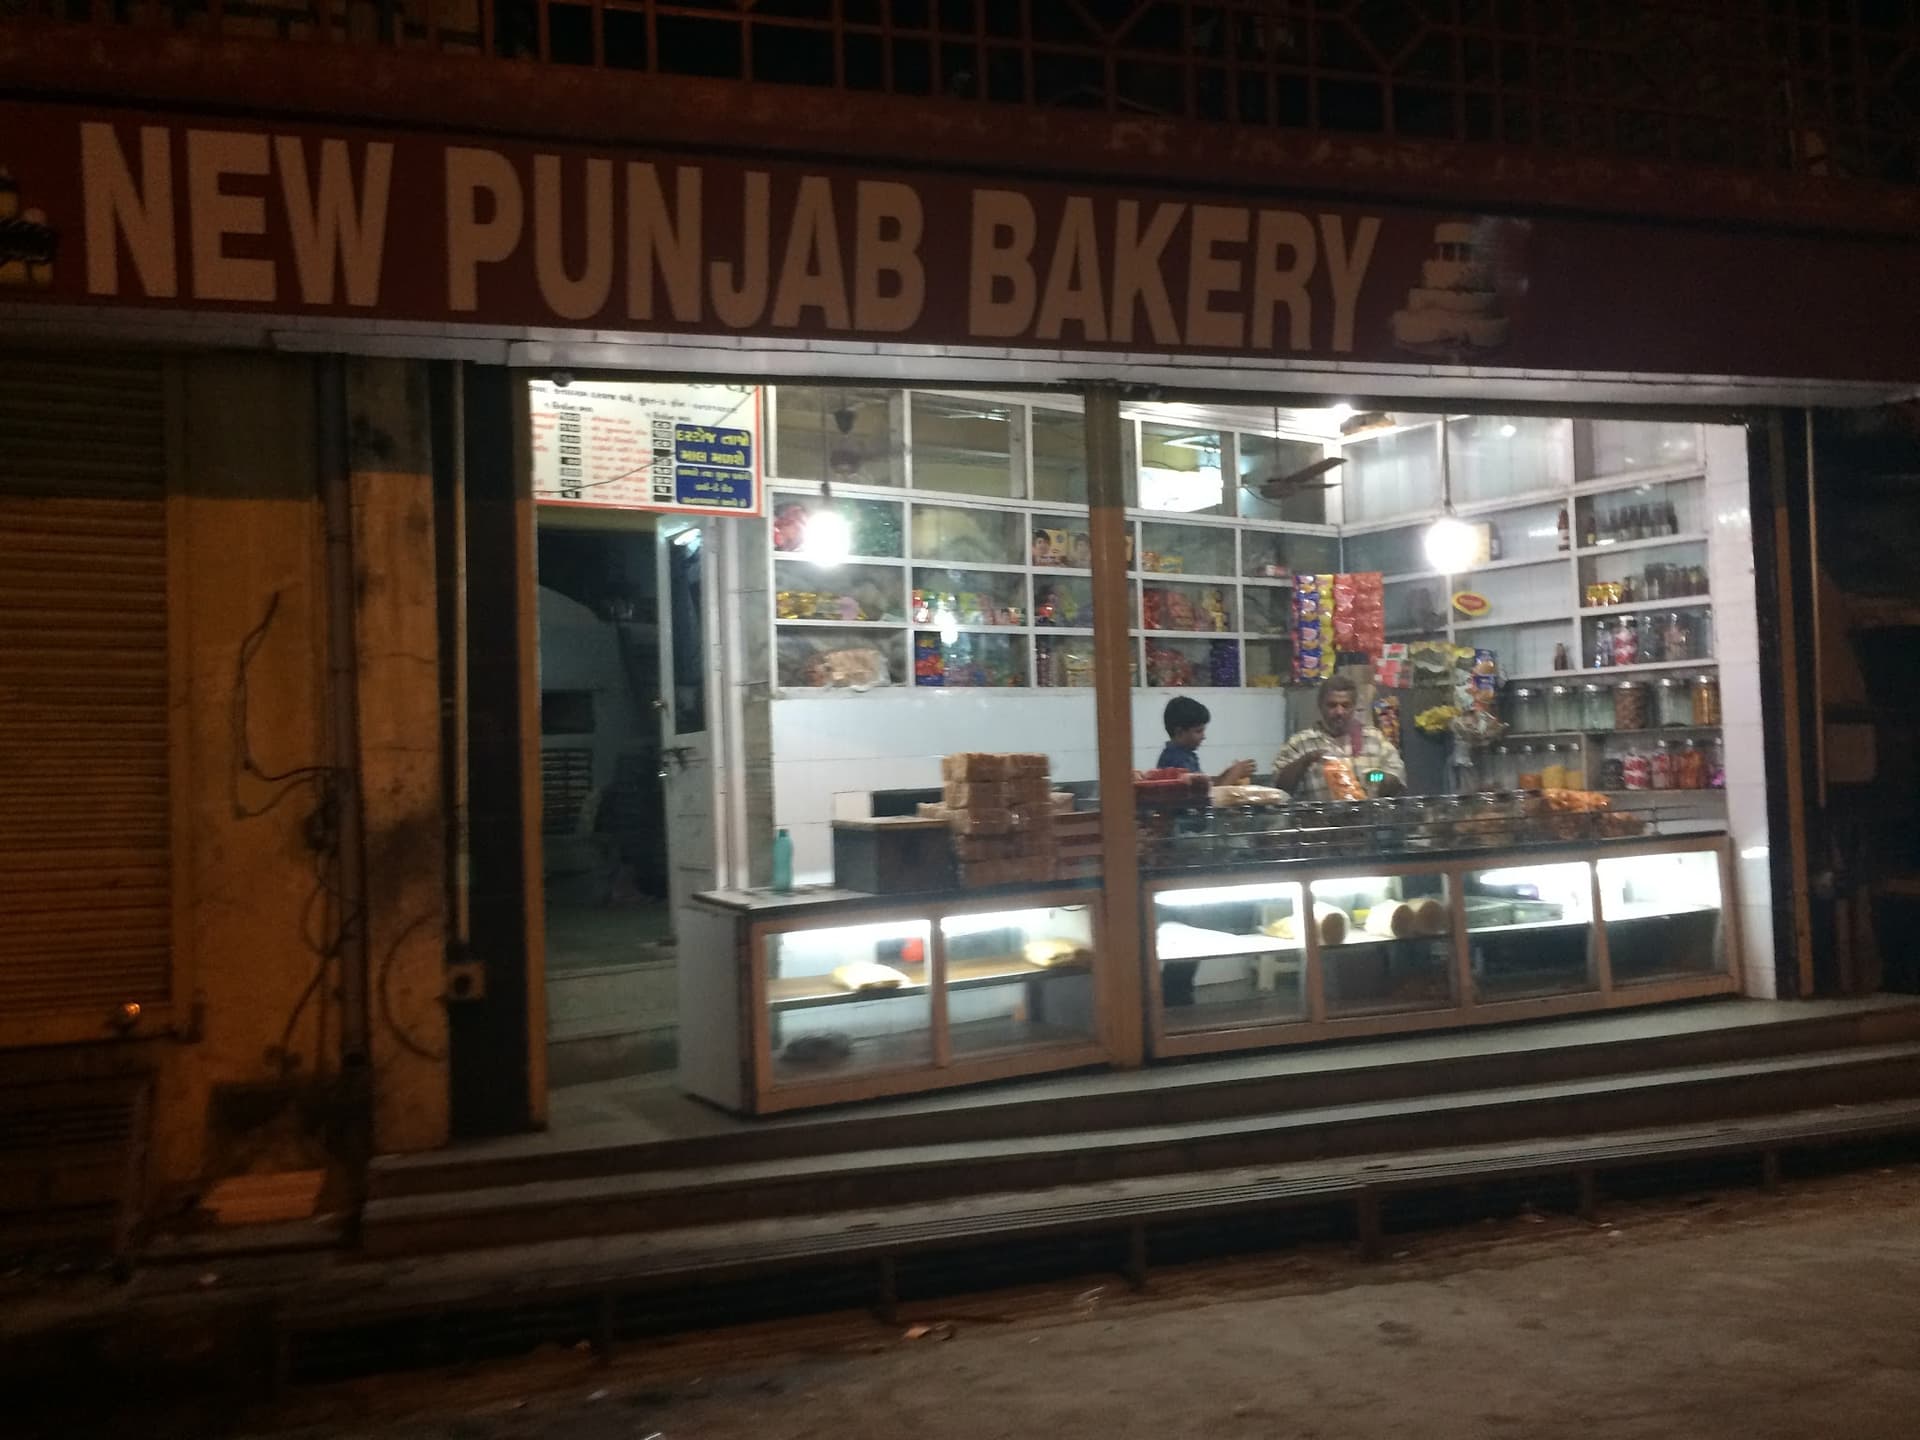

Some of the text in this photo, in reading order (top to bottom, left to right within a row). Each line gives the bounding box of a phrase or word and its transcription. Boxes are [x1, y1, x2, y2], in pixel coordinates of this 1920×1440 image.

[81, 121, 1382, 352] NEW PUNJAB BAKERY
